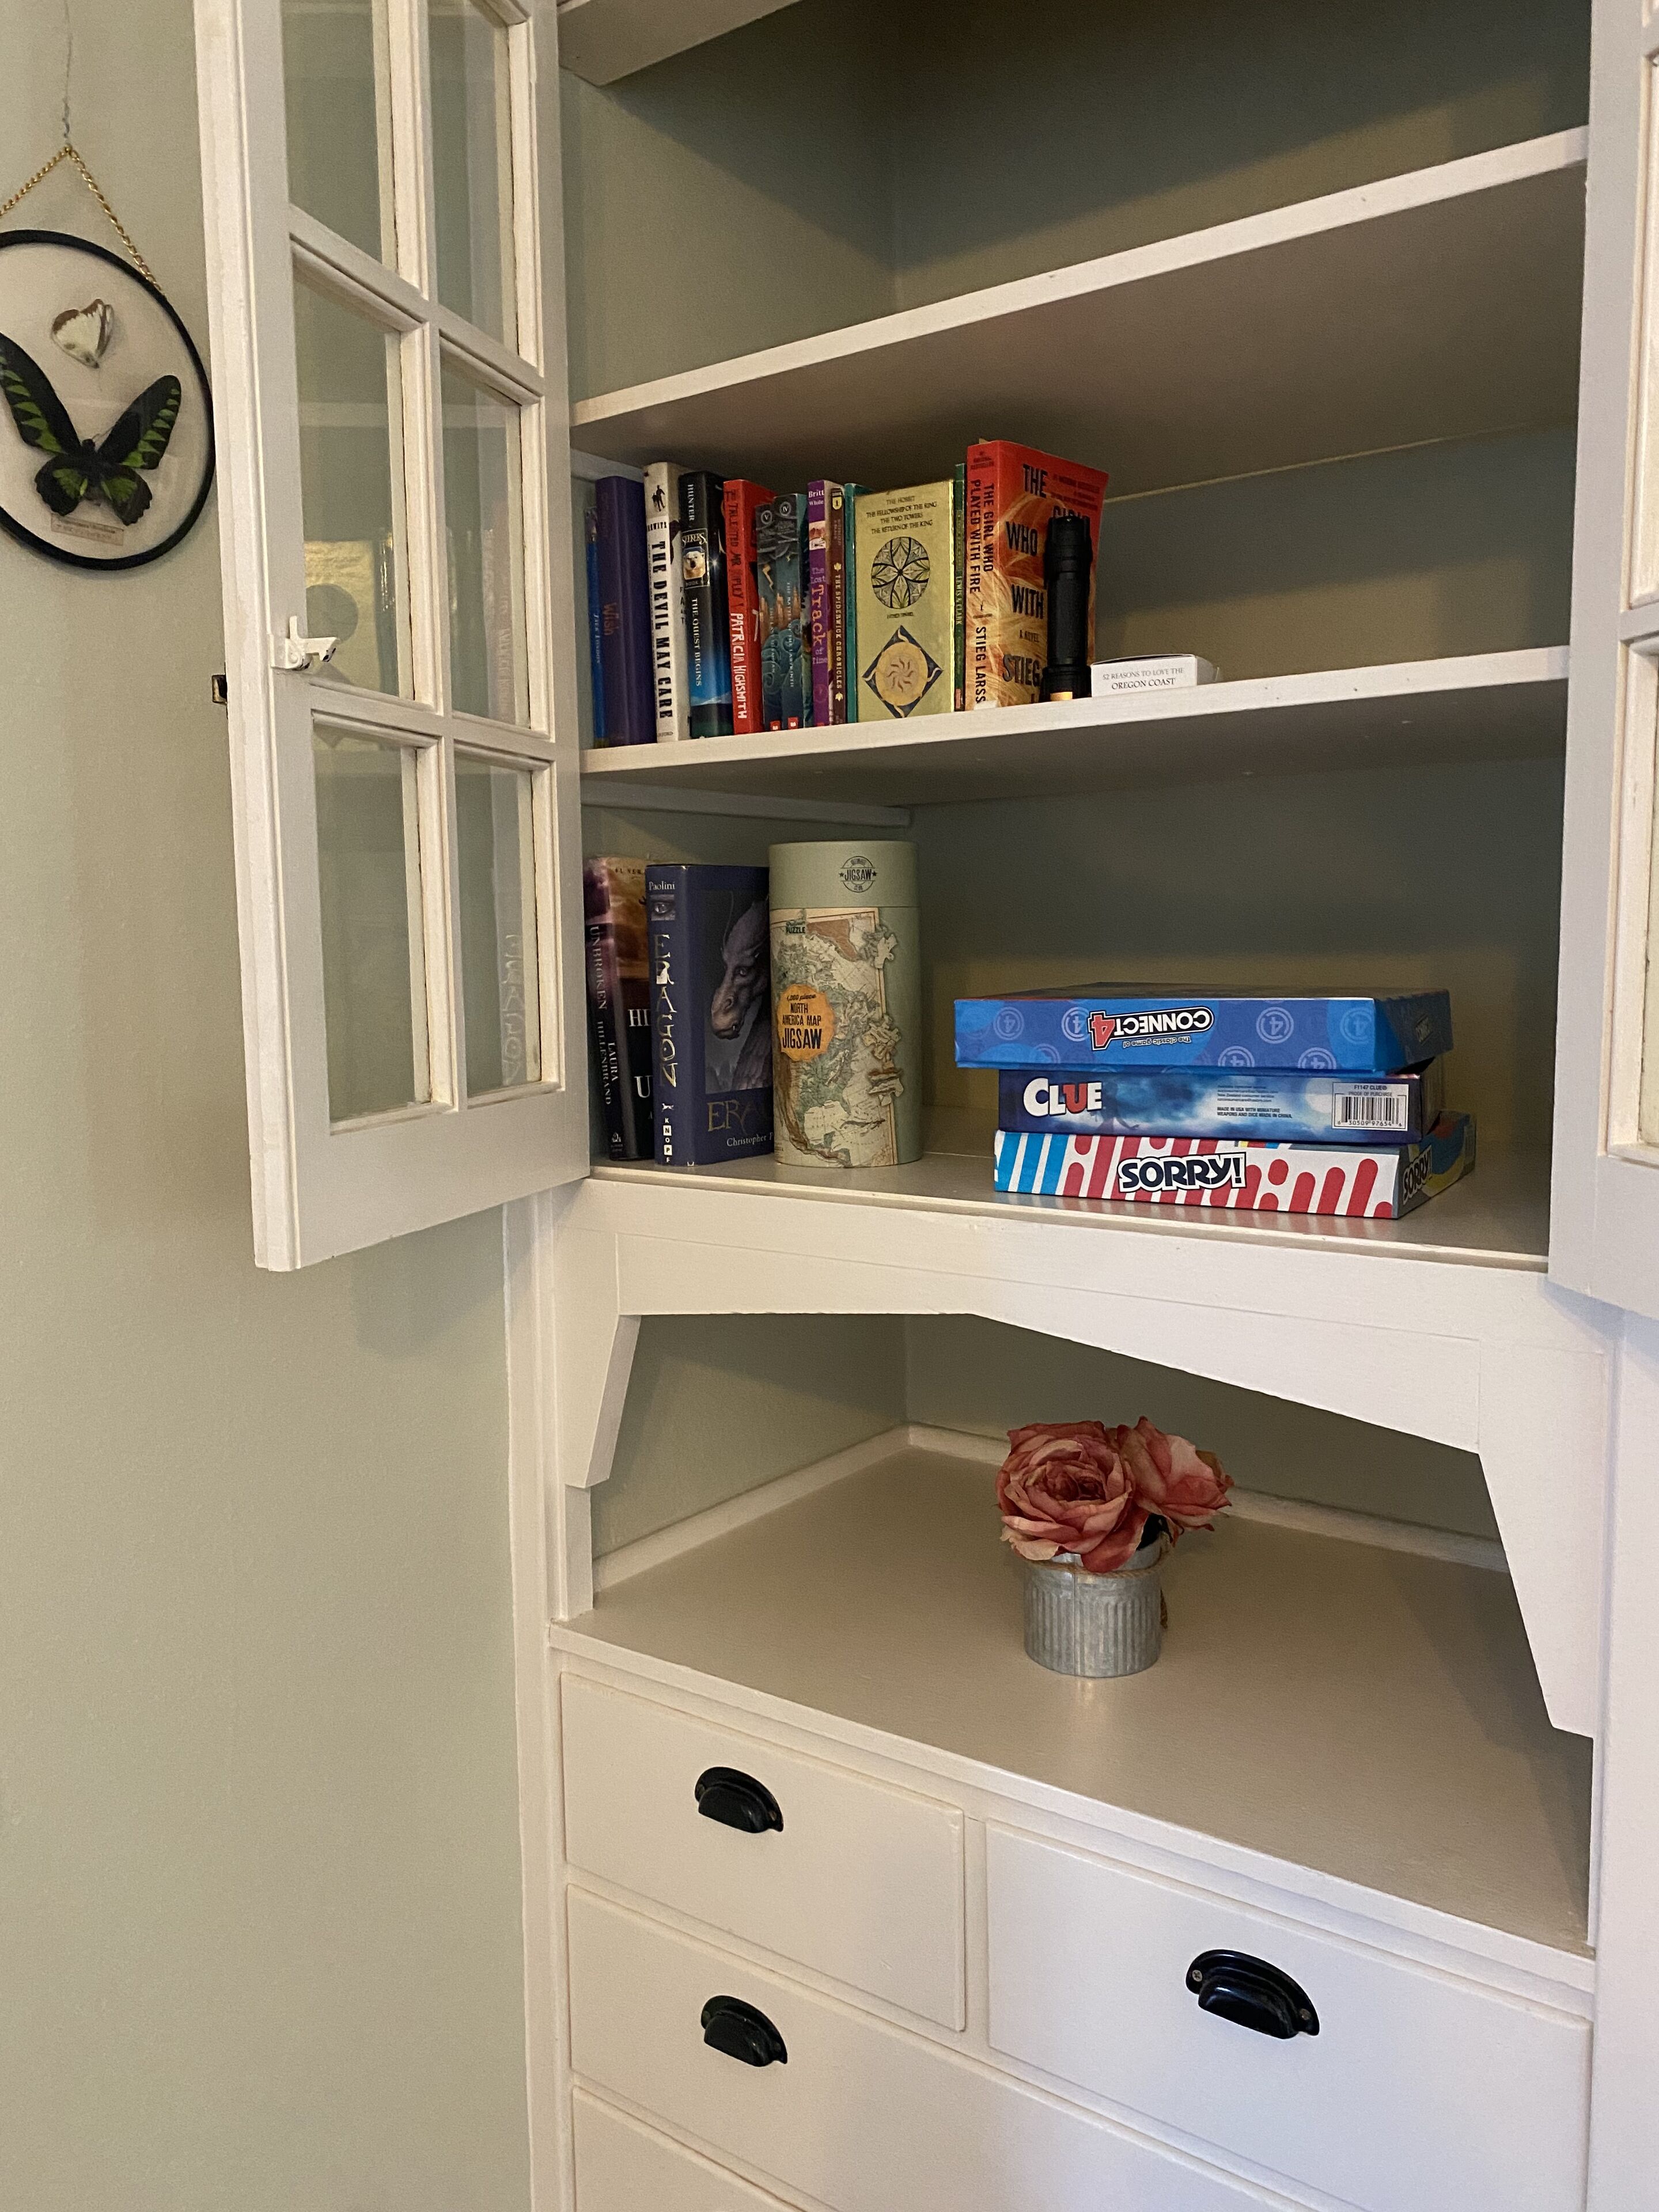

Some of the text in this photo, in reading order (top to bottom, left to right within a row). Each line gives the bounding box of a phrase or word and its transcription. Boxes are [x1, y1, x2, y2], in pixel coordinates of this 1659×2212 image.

[808, 489, 824, 498] Britt
[1022, 463, 1048, 499] THE
[970, 479, 981, 594] PLAYED WITH FIRE
[983, 483, 994, 573] THE GIRL WHO
[1005, 521, 1039, 557] WHO
[652, 540, 666, 574] THE
[653, 580, 669, 630] DEVIL
[812, 584, 826, 646] Track
[1011, 583, 1044, 620] WITH
[692, 618, 700, 650] QUEST
[656, 637, 671, 669] MAY
[730, 612, 747, 719] PATRICIA HIGHSMITH
[975, 626, 987, 704] STIEG LARSS
[1002, 653, 1041, 687] STIEG
[1111, 671, 1140, 679] REASONS
[1153, 668, 1169, 676] LOVE
[1111, 677, 1176, 690] OREGON COAST
[658, 677, 673, 718] CARE
[649, 880, 676, 891] Paolini
[844, 869, 872, 881] JIGSAW
[786, 926, 806, 934] PUZZLE
[590, 925, 607, 1009] UNBROKEN
[782, 1014, 821, 1027] AMERICA MAP
[790, 1002, 809, 1013] NORTH
[782, 1028, 823, 1050] JIGSAW
[1091, 1010, 1210, 1047] CONNECT 4
[1123, 1036, 1191, 1048] The classic game of
[597, 1021, 619, 1105] LAURA HILLENBRAND
[1023, 1077, 1102, 1117] CLUE
[726, 1134, 767, 1147] Christopher
[1120, 1156, 1244, 1190] SORRY!
[1403, 1145, 1432, 1206] SORRY!
